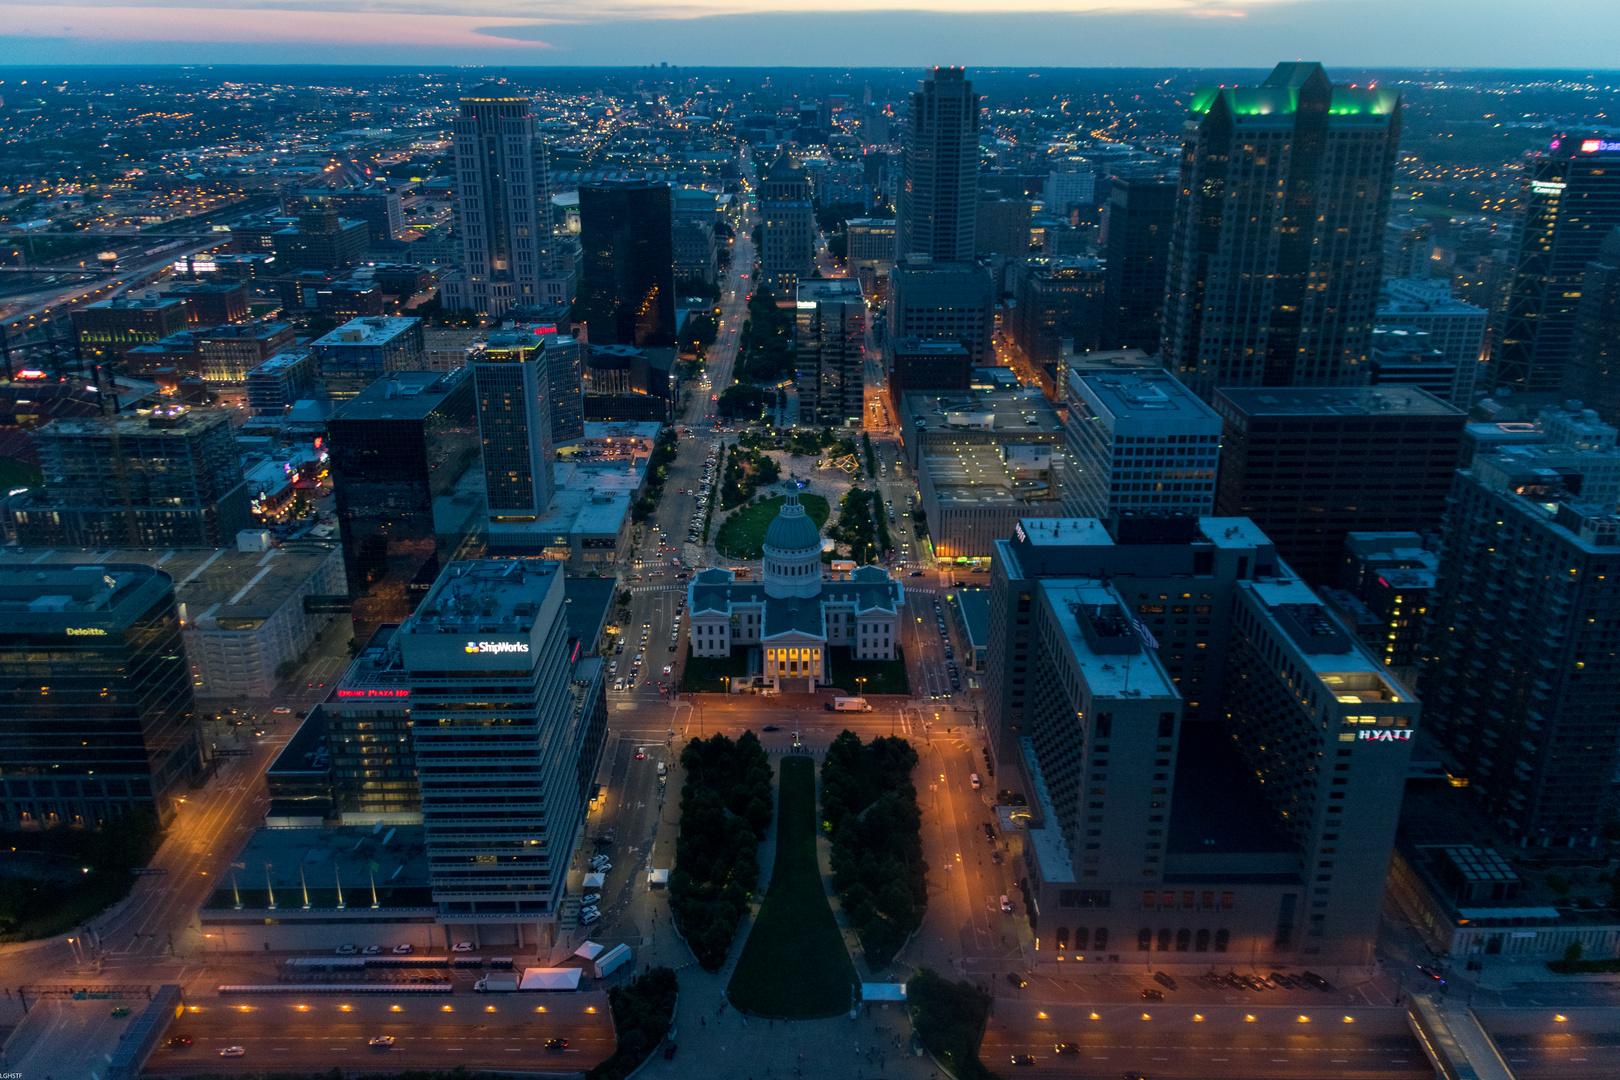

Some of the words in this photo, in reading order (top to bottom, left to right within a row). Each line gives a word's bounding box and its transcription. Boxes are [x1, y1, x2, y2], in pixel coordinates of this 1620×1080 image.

[534, 327, 557, 335] Hilton
[479, 642, 529, 654] ShipWorks
[1359, 730, 1414, 741] HYATT
